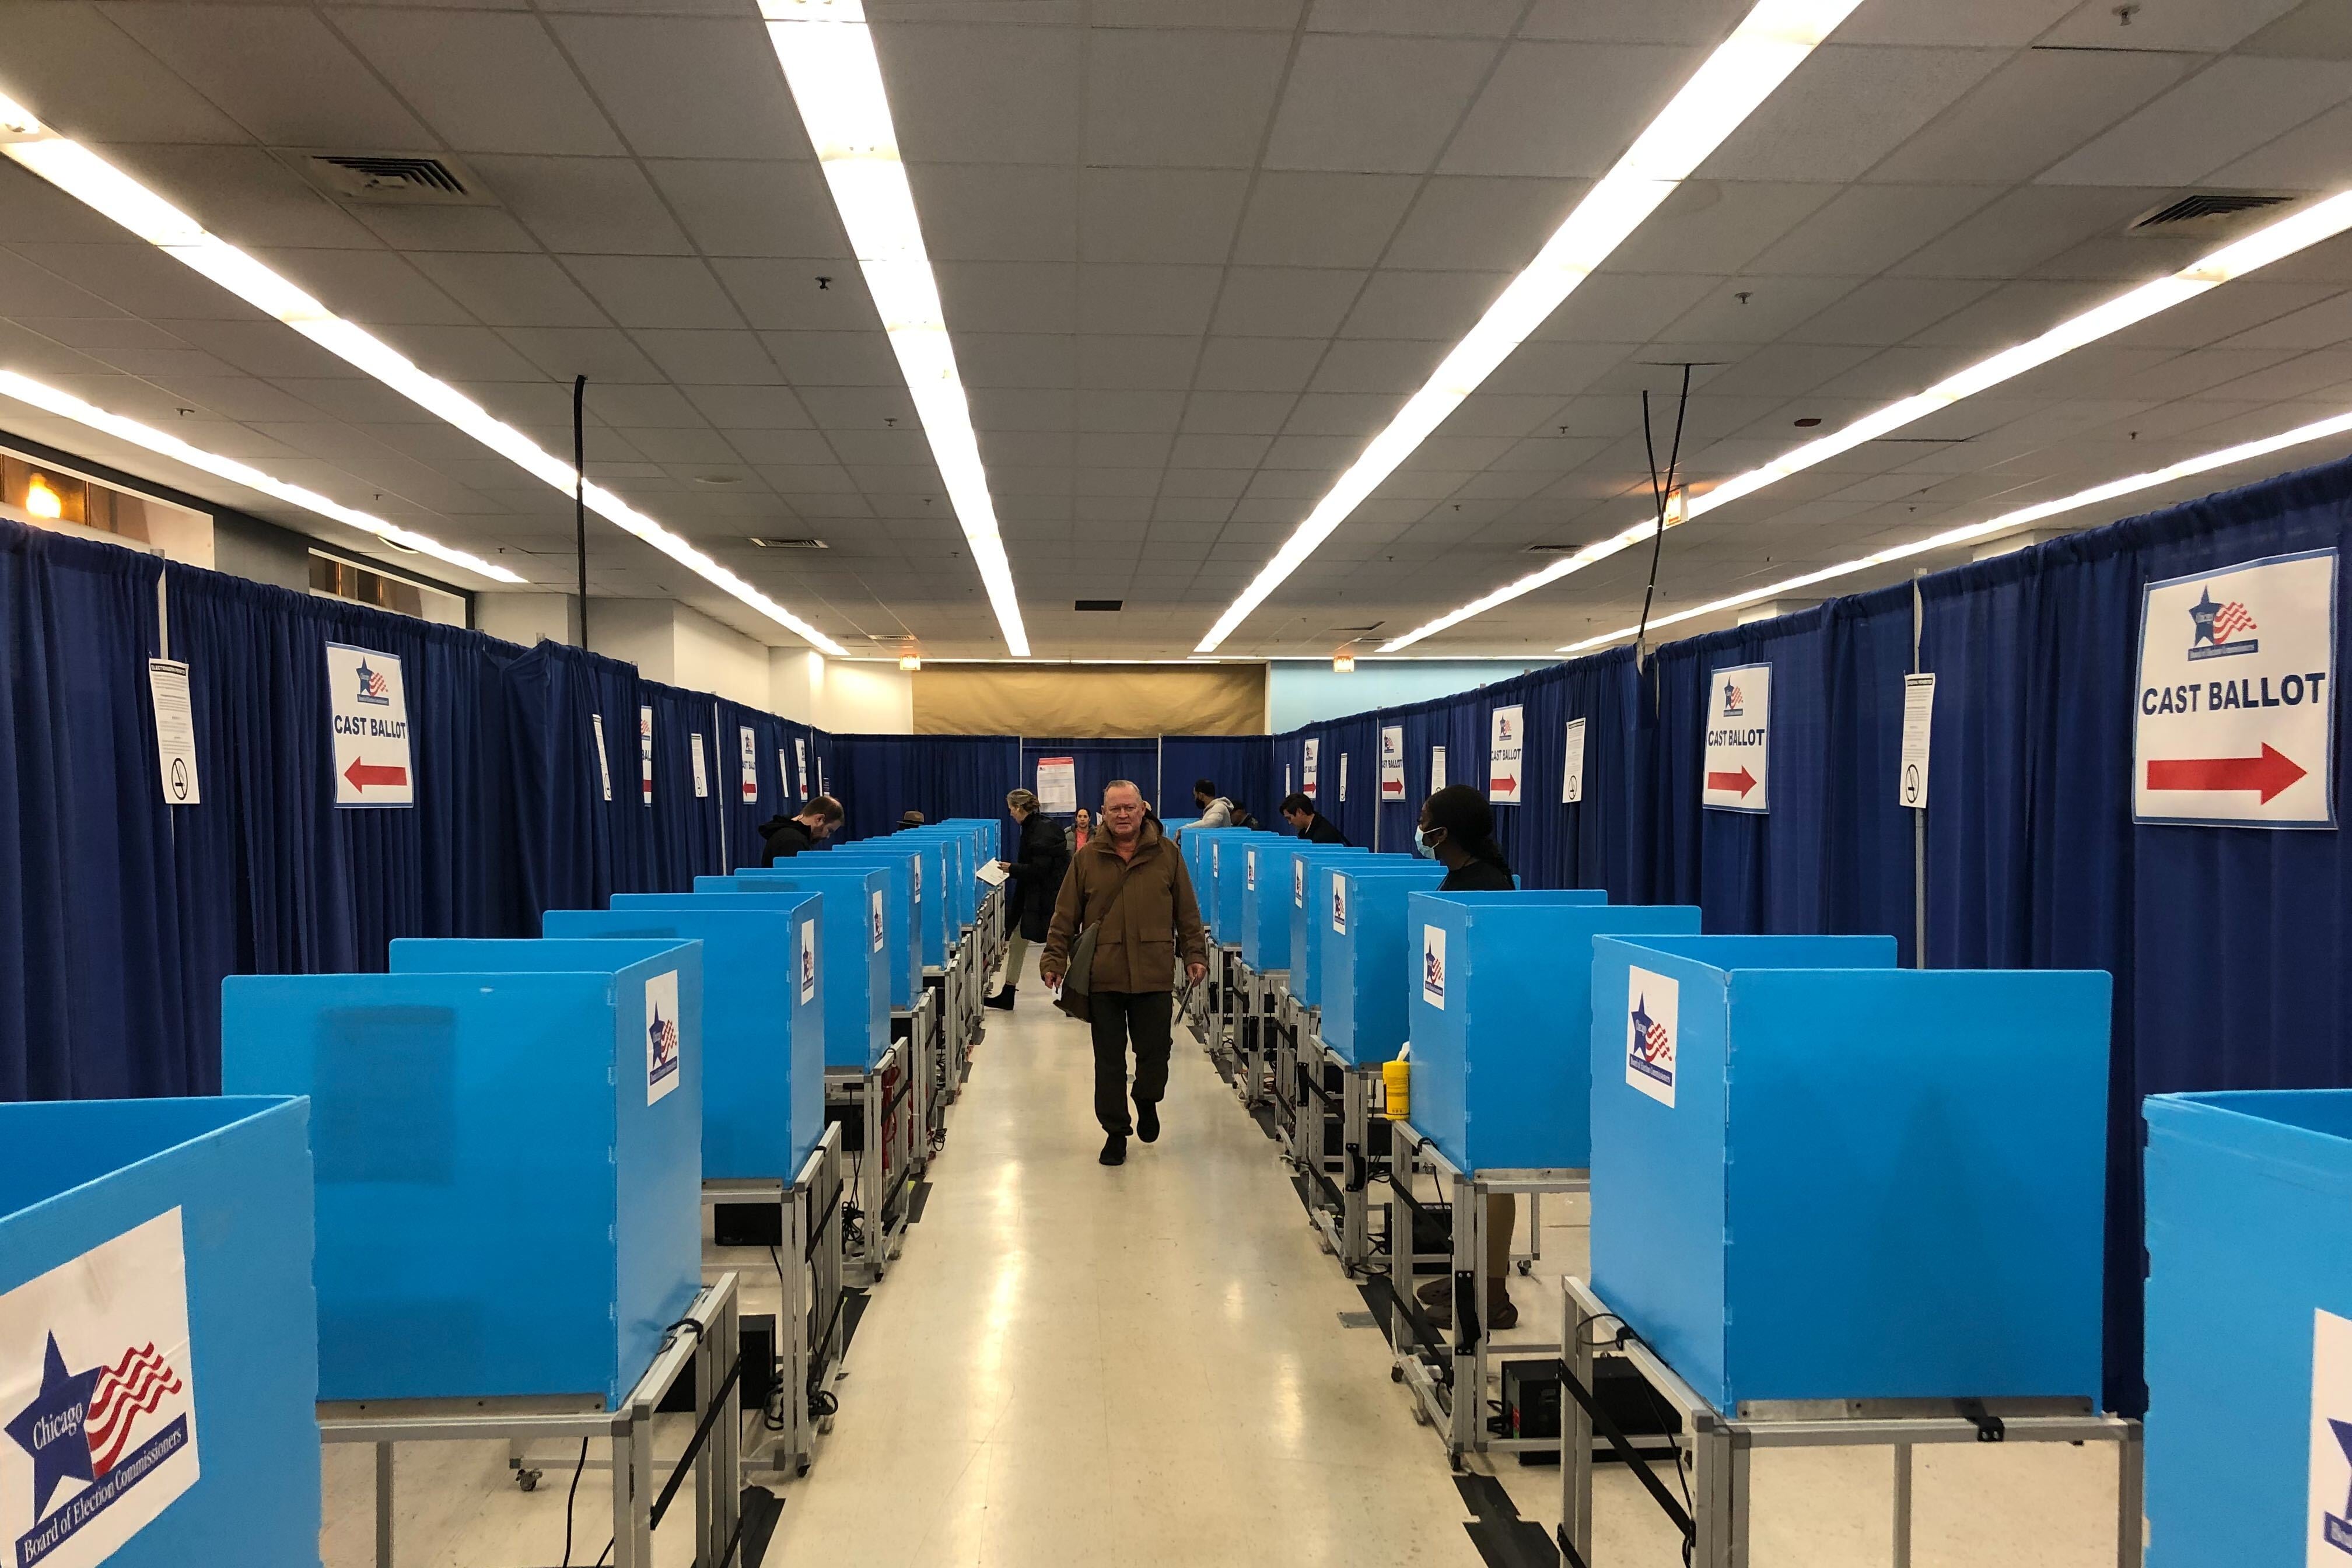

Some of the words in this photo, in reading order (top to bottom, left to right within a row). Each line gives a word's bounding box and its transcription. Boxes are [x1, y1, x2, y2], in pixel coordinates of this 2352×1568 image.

[2142, 684, 2202, 715] CAST
[2208, 672, 2326, 710] BALLOT
[334, 715, 367, 736] CAST
[371, 720, 406, 739] BALLOT
[1708, 730, 1727, 746] CAST
[1728, 729, 1765, 746] BALLOT
[1388, 759, 1402, 769] BALLOT
[1503, 748, 1521, 761] BALLOT
[33, 1402, 83, 1450] Chicago
[24, 1518, 58, 1563] Board
[61, 1506, 71, 1534] of
[74, 1483, 115, 1525] Election
[116, 1427, 181, 1490] Commissioners
